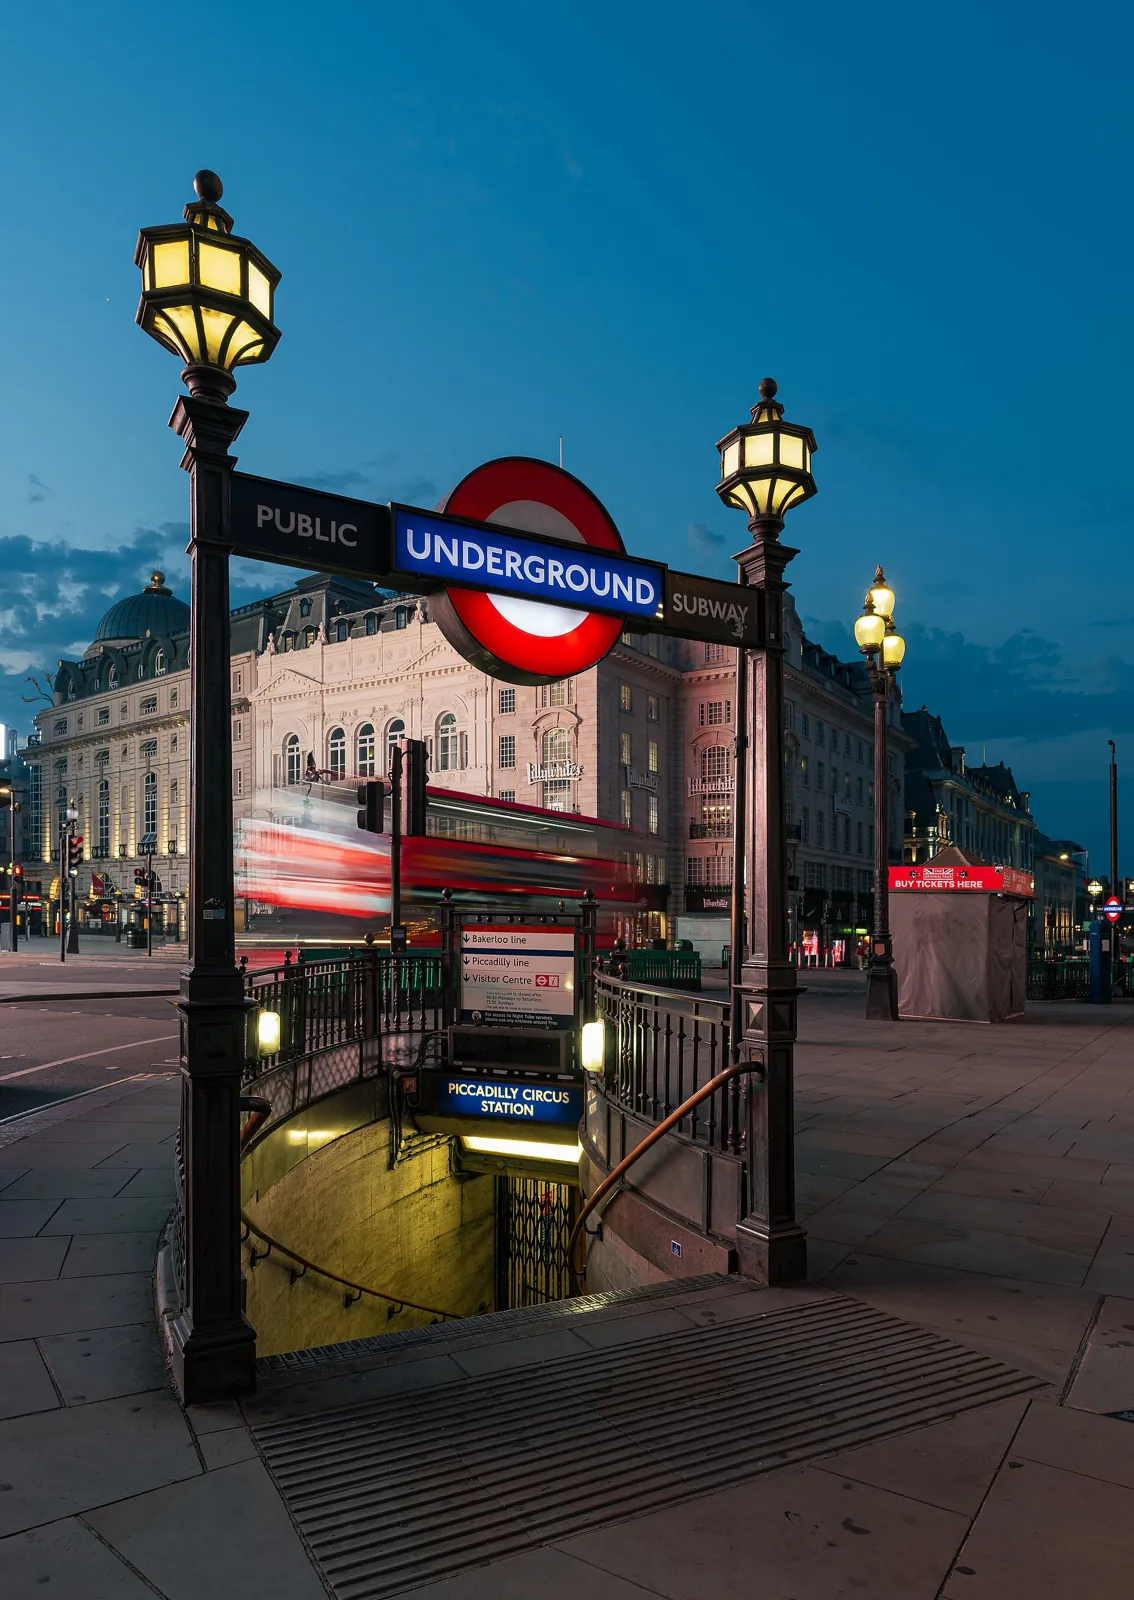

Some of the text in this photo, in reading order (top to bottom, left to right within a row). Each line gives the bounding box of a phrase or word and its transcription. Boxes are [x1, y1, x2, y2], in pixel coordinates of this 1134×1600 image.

[257, 504, 358, 547] PUBLIC
[406, 528, 655, 605] UNDERGROUND
[672, 592, 749, 624] SUBWAY
[895, 880, 983, 888] BUY TICKETS HERE
[472, 935, 527, 944] Bakerloo line
[472, 957, 530, 967] Piccadilly line
[472, 974, 500, 983] Visitor
[502, 976, 532, 985] Centre
[448, 1082, 519, 1099] PICCADILLY
[522, 1089, 570, 1104] CIRCUS
[481, 1100, 534, 1117] STATION
